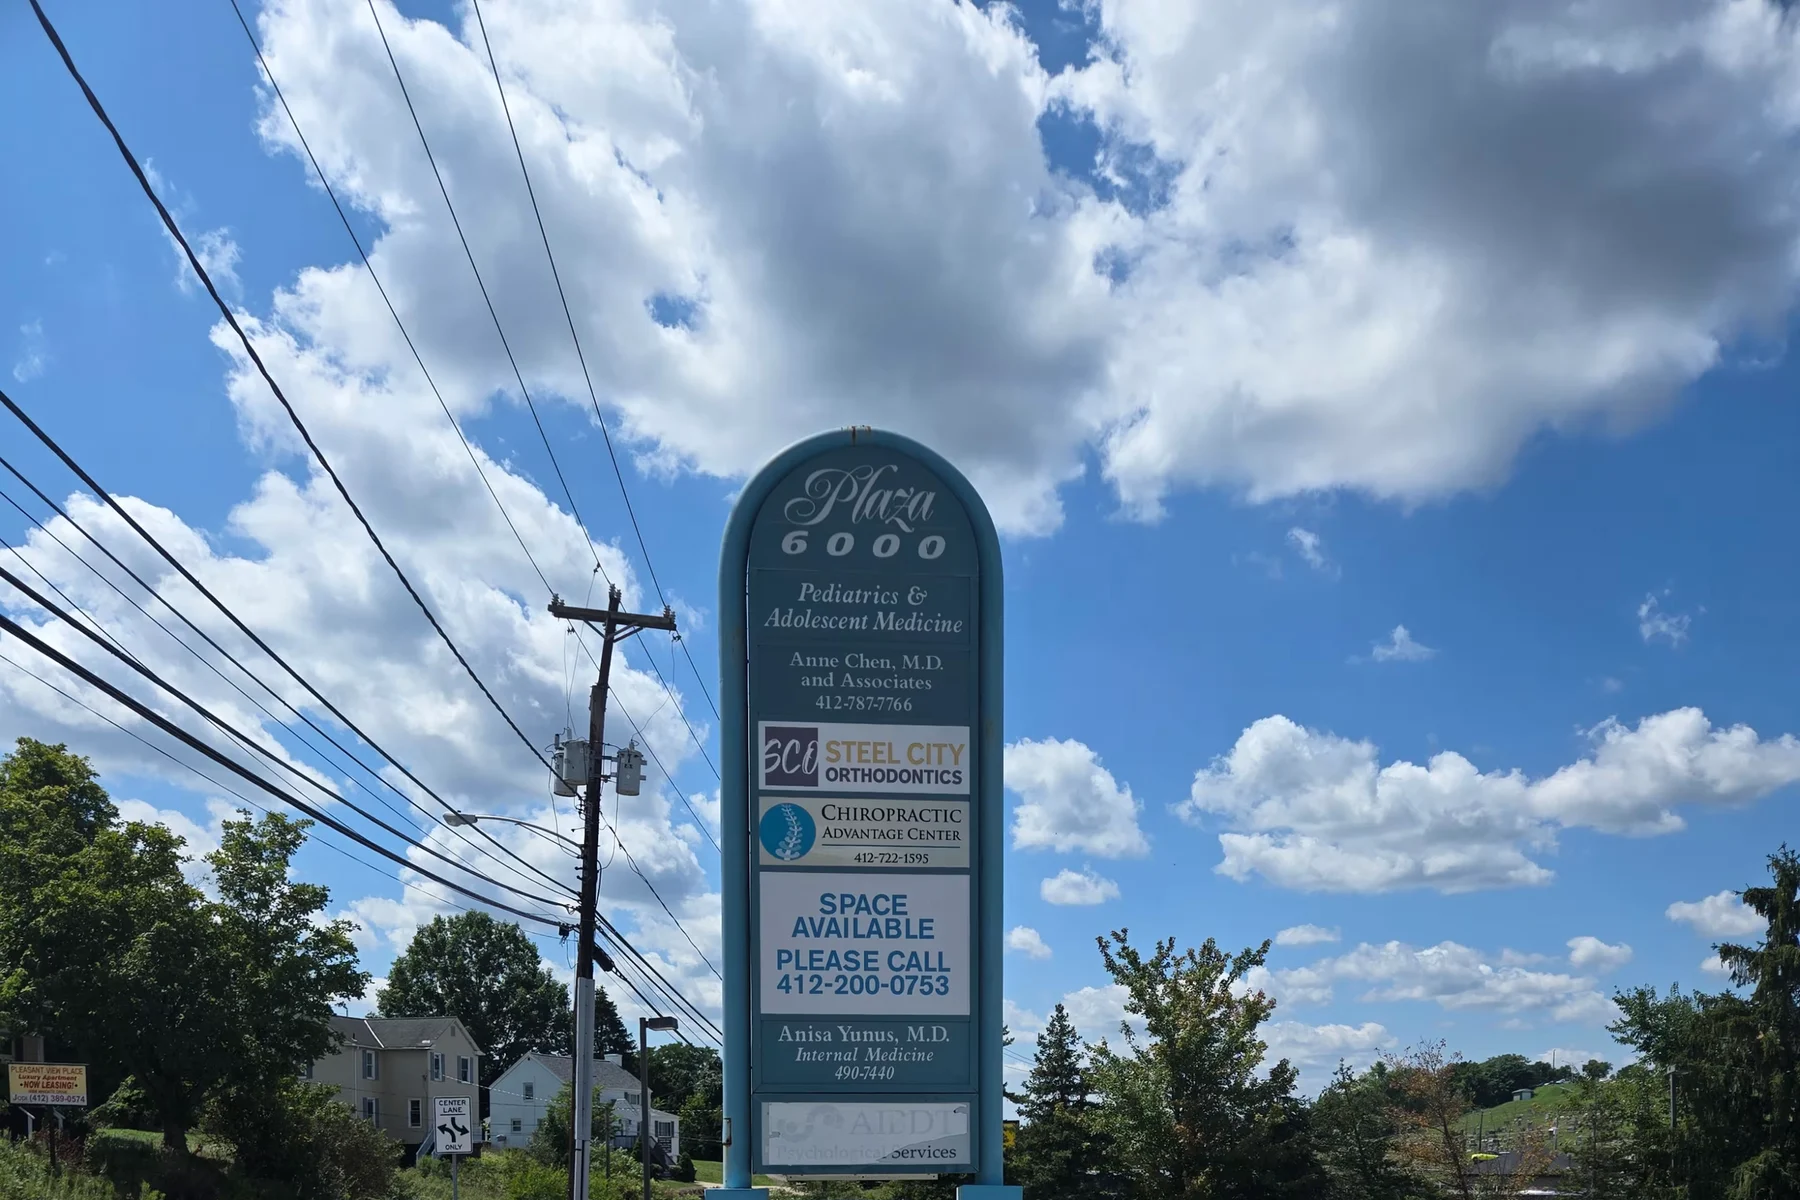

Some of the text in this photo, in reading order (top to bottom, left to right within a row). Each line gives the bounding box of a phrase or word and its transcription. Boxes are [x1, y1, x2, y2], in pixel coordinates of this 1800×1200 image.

[784, 464, 936, 532] Plaza
[797, 582, 927, 605] Pediatrics &
[764, 608, 963, 633] Adolescent Medicine
[789, 652, 944, 671] Anne Chen, M.D.
[801, 672, 932, 690] and Associates
[815, 695, 913, 712] 412-787-7766
[825, 740, 965, 766] STEEL CITY
[825, 766, 963, 785] ORTHODONTICS
[821, 804, 962, 824] CHIROPRACTIC
[854, 852, 929, 864] 412-722-1595
[819, 892, 908, 916] SPACE
[791, 916, 935, 940] AVAILABLE
[776, 949, 951, 973] PLEASE CALL
[776, 973, 949, 996] 412-200-0753
[778, 1025, 950, 1044] Anisa Yunus, M.D.
[795, 1047, 934, 1062] Internal Medicine
[11, 1066, 44, 1074] PLEASANT
[835, 1066, 895, 1080] 490-7440
[29, 1094, 48, 1102] (412)
[891, 1145, 957, 1159] Services
